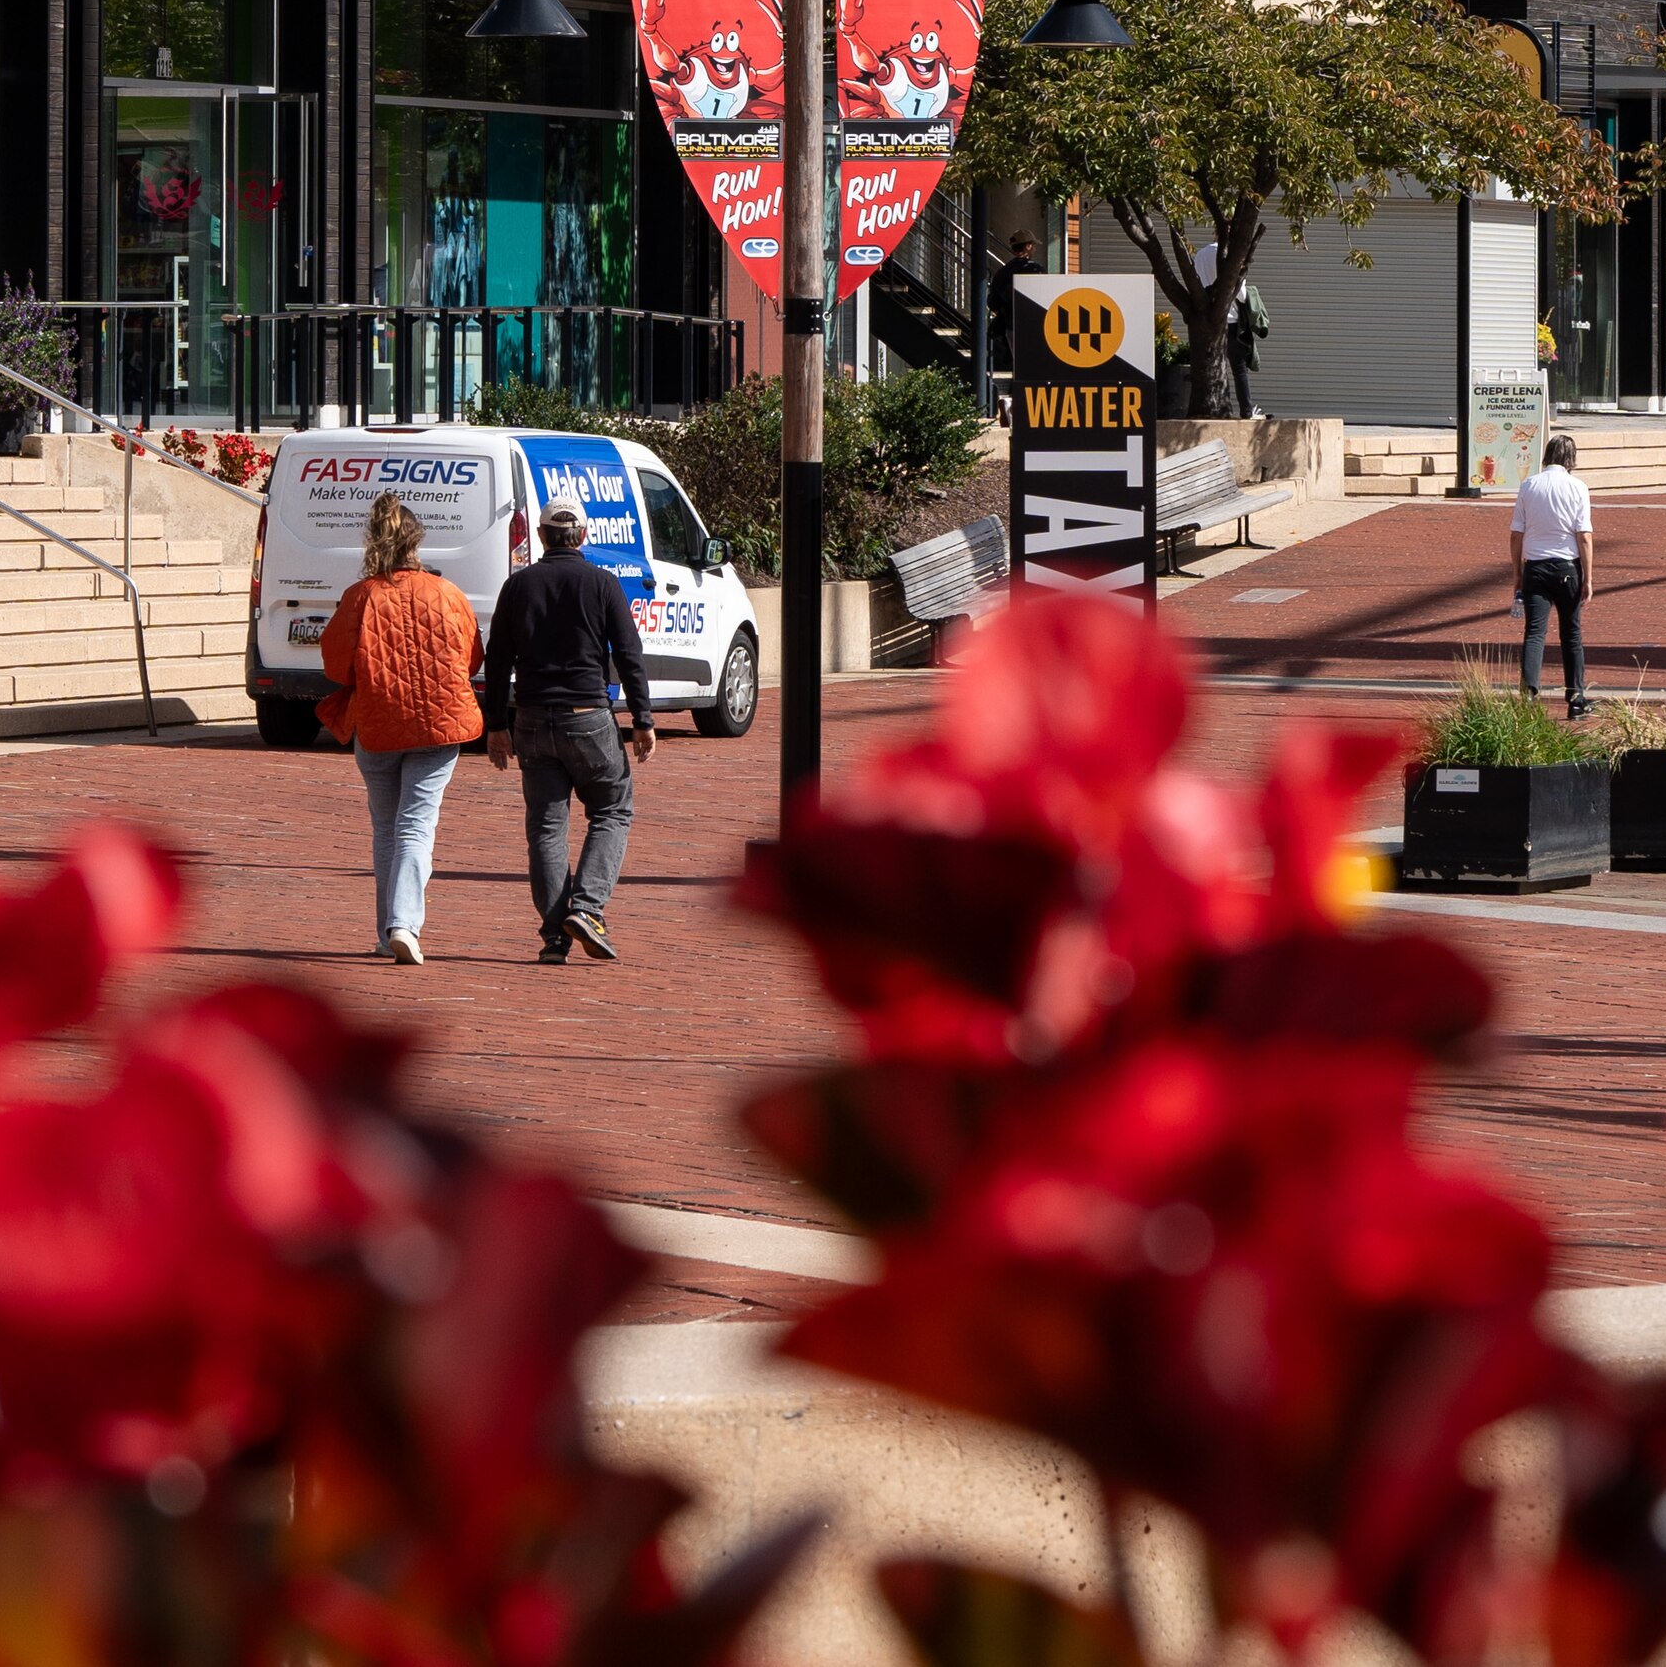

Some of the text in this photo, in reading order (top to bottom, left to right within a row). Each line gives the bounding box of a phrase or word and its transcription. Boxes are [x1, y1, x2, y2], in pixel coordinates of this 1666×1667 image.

[713, 99, 721, 116] 1
[914, 98, 921, 116] 1
[676, 133, 779, 146] BALTIMORE
[845, 133, 950, 146] BALTIMORE
[712, 165, 761, 204] RUN
[846, 168, 897, 208] RUN
[722, 186, 782, 233] HON!
[857, 190, 921, 238] HON!
[1474, 387, 1542, 395] CREPE LENA
[1024, 386, 1144, 428] WATER
[300, 458, 478, 486] FASTSIGNS
[542, 464, 626, 503] Make Your
[309, 487, 460, 503] Make Your Statement
[415, 513, 449, 521] OLUMBIA,
[584, 511, 636, 546] ement
[1024, 435, 1144, 620] TAX
[619, 564, 643, 578] Solutions
[631, 600, 705, 634] FASTSIGNS
